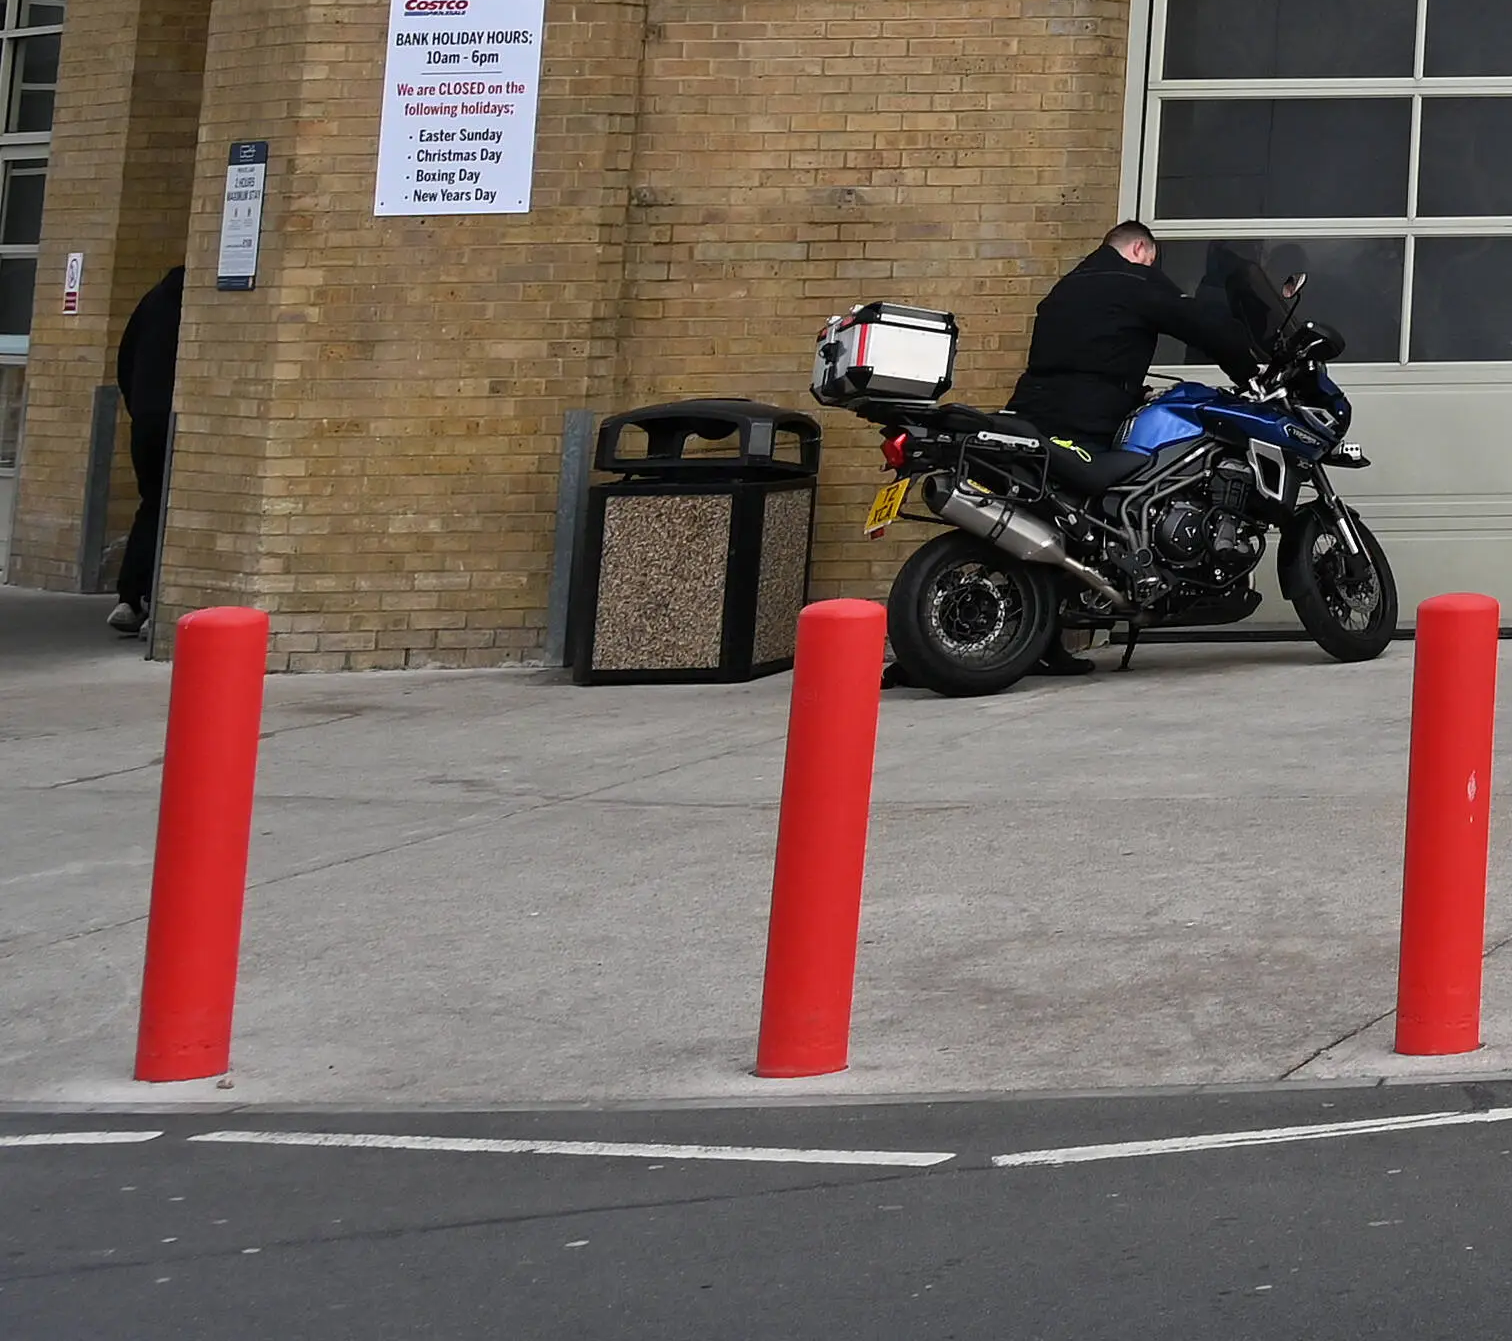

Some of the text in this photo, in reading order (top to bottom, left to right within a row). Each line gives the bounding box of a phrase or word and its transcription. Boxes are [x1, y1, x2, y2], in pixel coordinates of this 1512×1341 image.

[405, 0, 468, 10] COSTCO
[396, 32, 429, 46] BANK
[432, 31, 484, 45] HOLIDAY
[426, 51, 460, 64] 10am
[471, 50, 499, 66] 6pm
[397, 81, 525, 96] We are CLOSED on the
[405, 103, 457, 117] following
[419, 128, 502, 143] Easter Sunday
[417, 148, 502, 163] Christmas Day
[416, 168, 480, 184] Boxing Day
[413, 188, 497, 203] New Years Day
